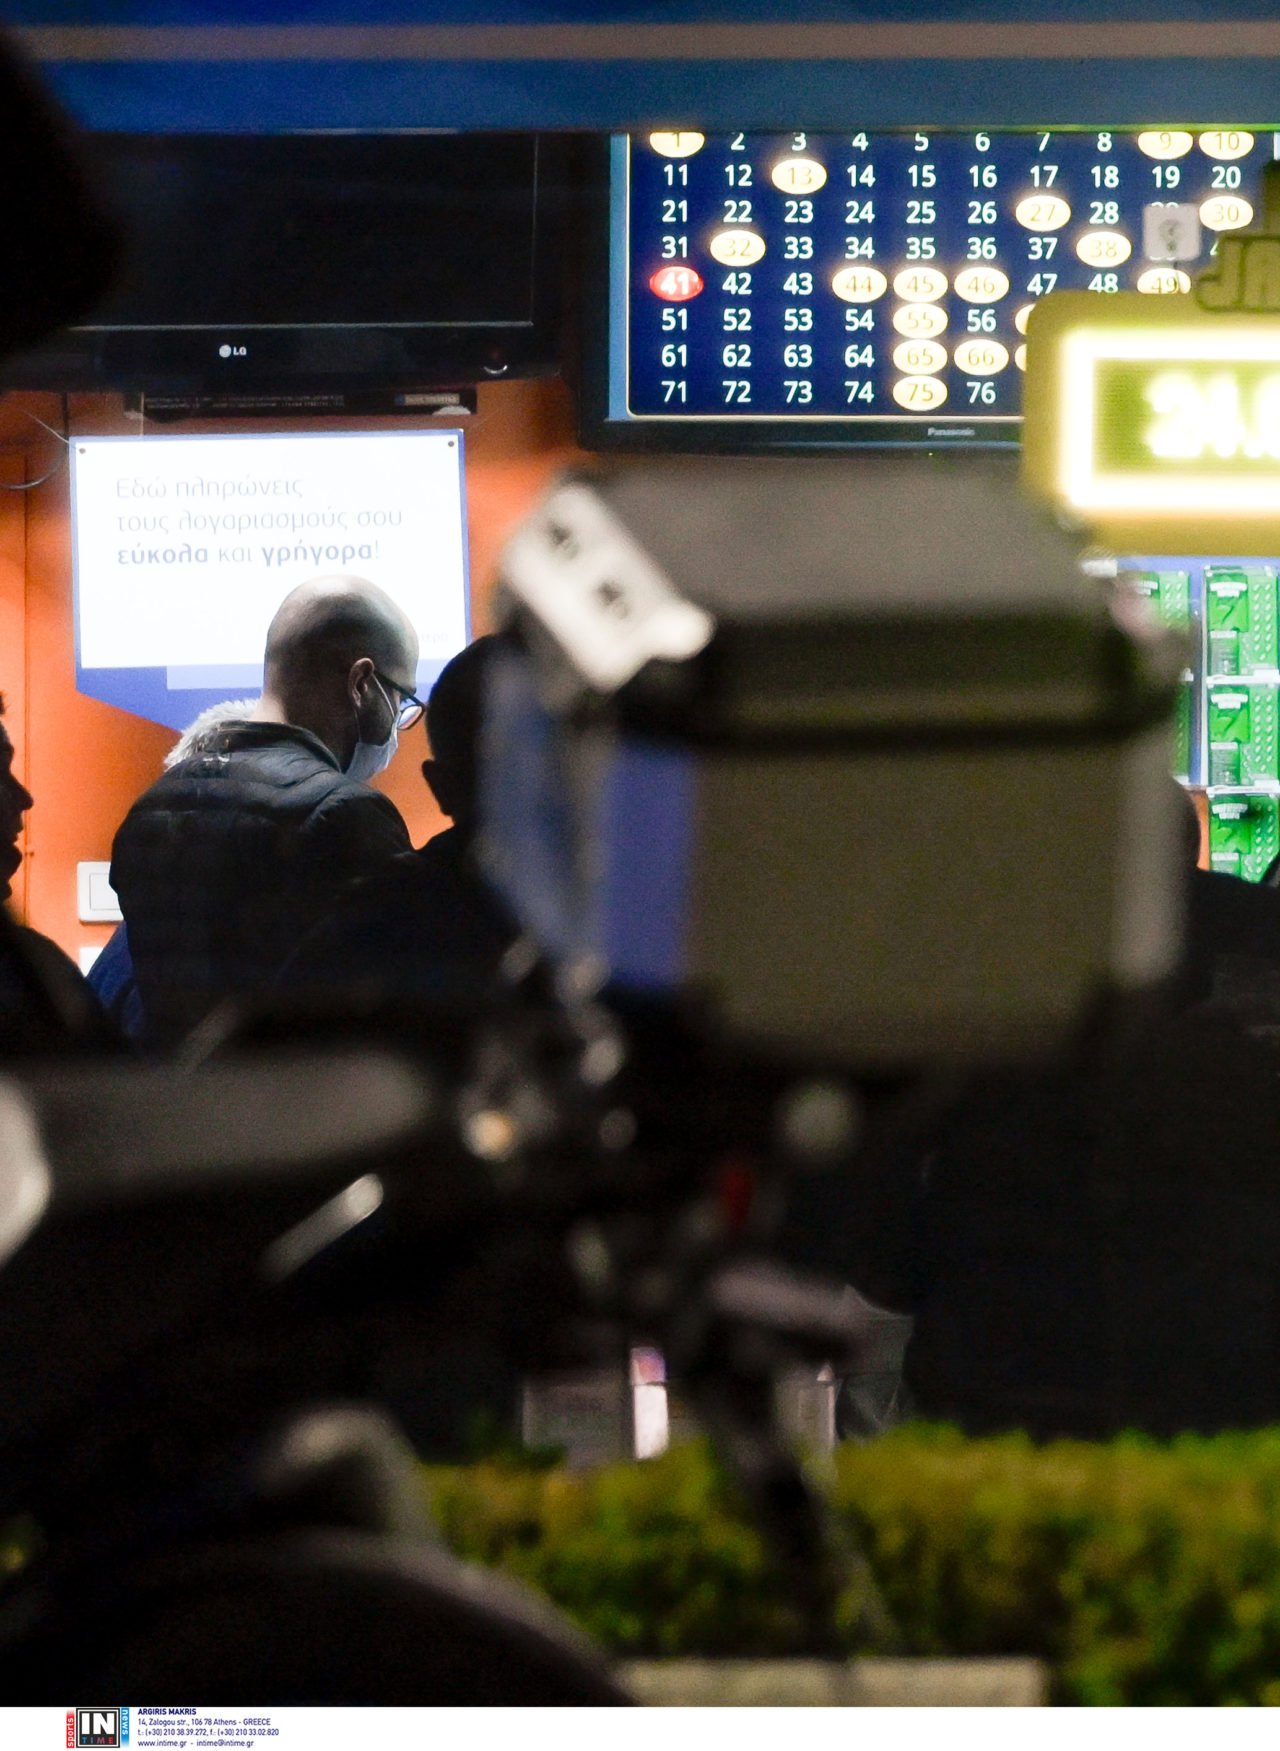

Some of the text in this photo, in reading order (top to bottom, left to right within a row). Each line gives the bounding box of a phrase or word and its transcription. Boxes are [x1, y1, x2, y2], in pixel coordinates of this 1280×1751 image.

[730, 132, 745, 151] 2
[791, 132, 807, 152] 3
[851, 132, 869, 152] 4
[914, 132, 929, 152] 5
[975, 132, 991, 152] 6
[1037, 131, 1051, 152] 7
[1096, 132, 1113, 153] 8
[1159, 131, 1173, 150] 9
[1214, 131, 1241, 150] 10
[663, 163, 1242, 189] 11 12 13 14 15 16 17 18 19 20
[661, 199, 1241, 225] 21 22 23 24 25 26 27 28 30
[661, 235, 1118, 261] 31 32 33 34 35 36 37 38
[661, 272, 1178, 296] 41 42 43 44 45 46 47 48 49
[661, 307, 997, 332] 51 52 53 54 55 56
[232, 346, 247, 356] LG
[661, 343, 996, 369] 61 62 63 64 65 66
[661, 380, 997, 405] 71 72 73 74 75 76
[115, 473, 303, 502] Εδώ πληρώνεις
[116, 505, 403, 536] τους λογαριασμούς σου
[117, 538, 380, 567] εύκολα και γρήγορα!
